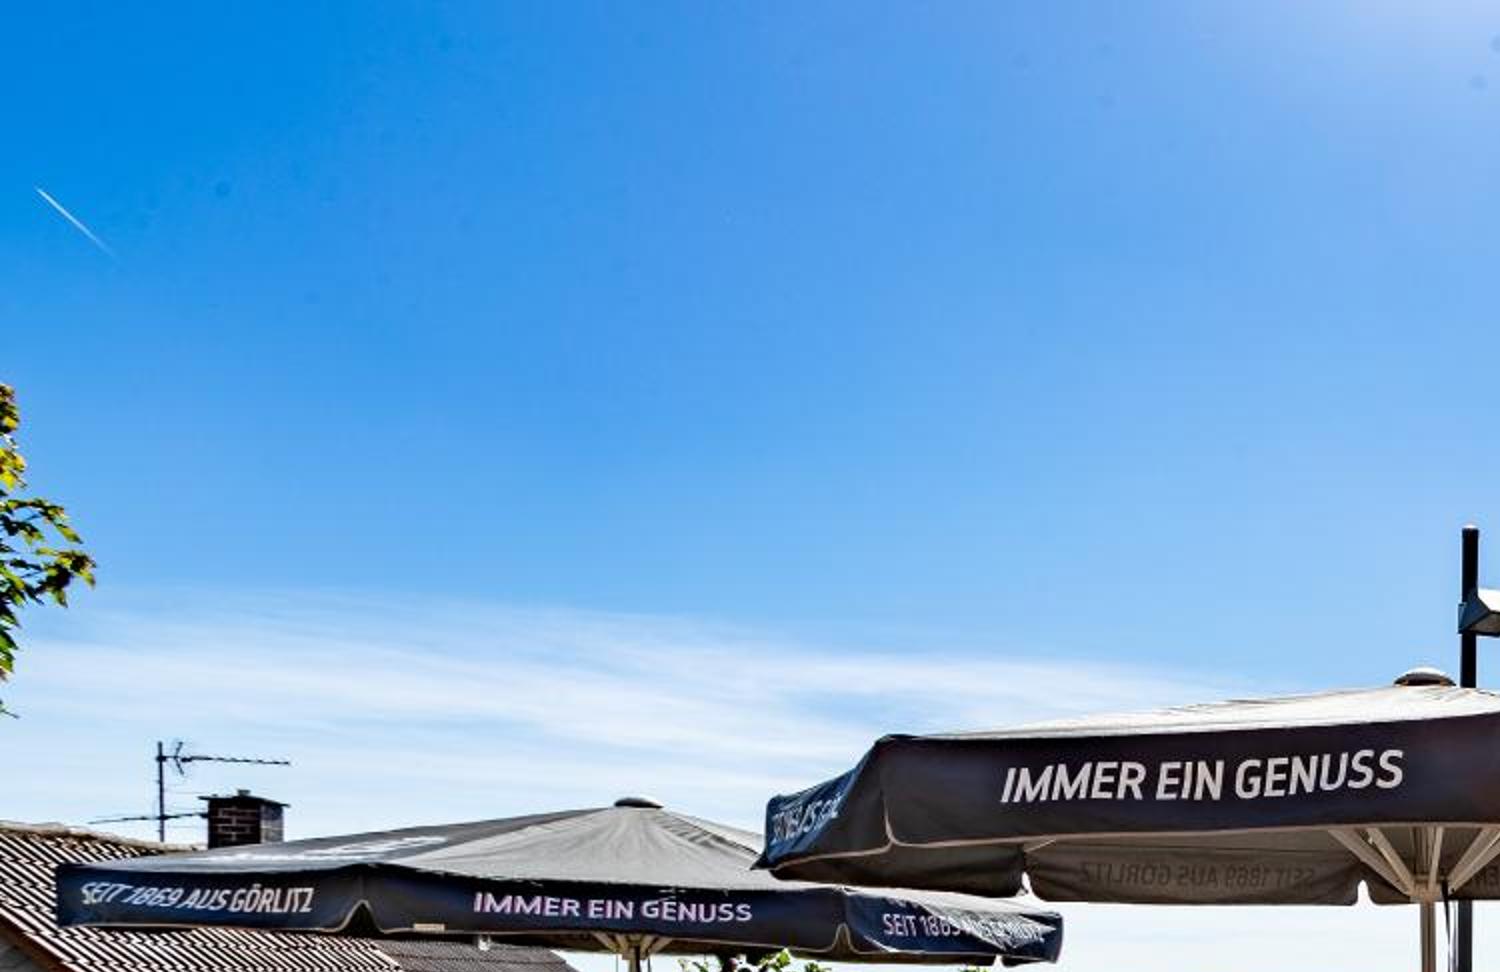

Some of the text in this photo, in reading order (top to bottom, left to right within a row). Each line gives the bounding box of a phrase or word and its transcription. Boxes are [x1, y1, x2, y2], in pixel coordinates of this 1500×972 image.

[1000, 749, 1404, 803] IMMER EIN GENUSS
[81, 882, 315, 913] SEIT 1869 AUS GÖRLITZ
[473, 892, 753, 923] IMMER EIN GENUSS
[882, 913, 917, 937] SEIT
